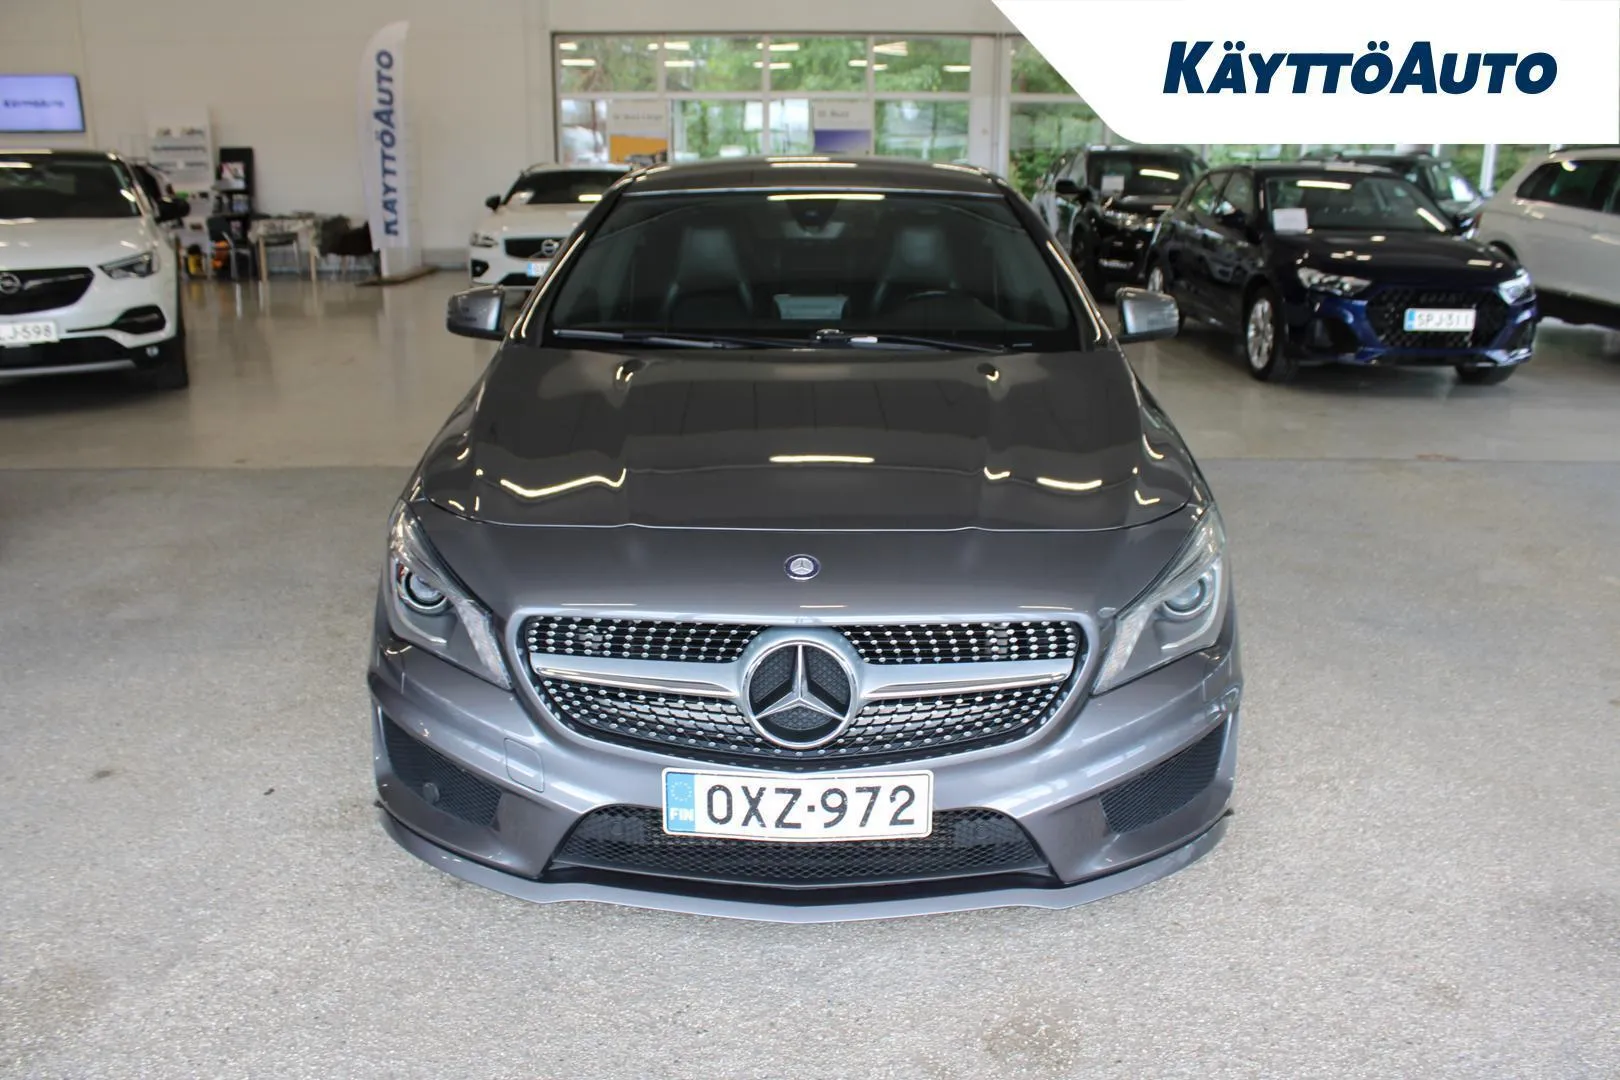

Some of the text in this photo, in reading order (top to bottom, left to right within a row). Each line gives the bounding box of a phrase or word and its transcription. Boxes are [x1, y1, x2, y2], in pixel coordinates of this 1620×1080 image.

[0, 325, 52, 340] J-598
[706, 784, 916, 828] OXZ-972
[669, 807, 695, 821] FIN
